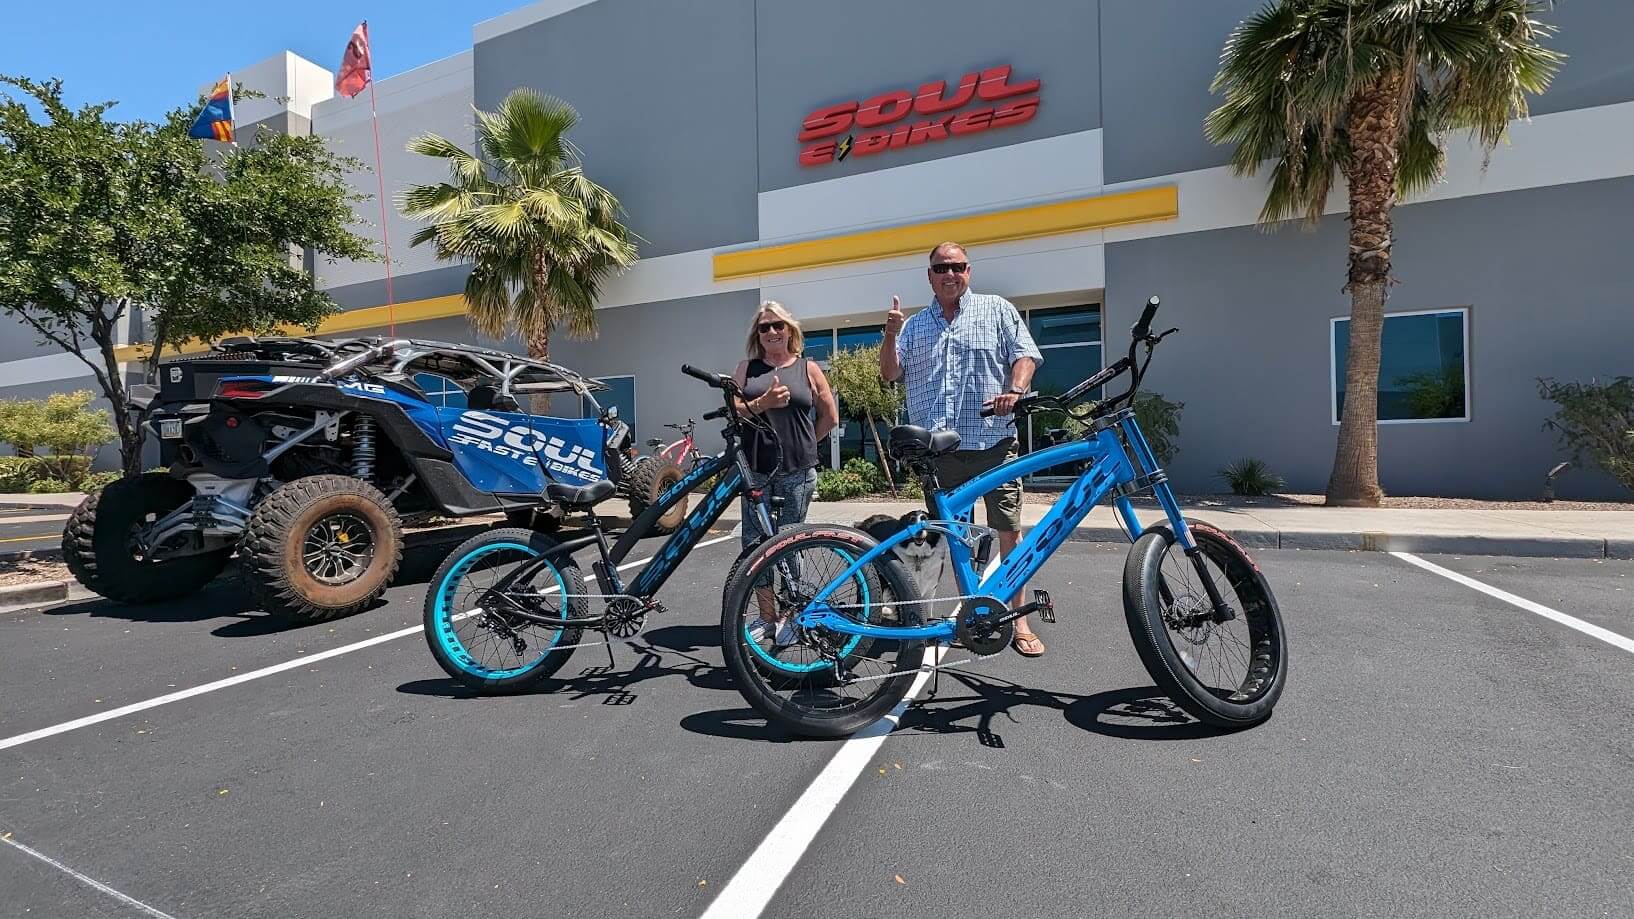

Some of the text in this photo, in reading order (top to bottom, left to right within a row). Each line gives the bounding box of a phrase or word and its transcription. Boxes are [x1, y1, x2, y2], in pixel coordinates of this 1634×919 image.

[798, 64, 1040, 143] SOUL
[447, 433, 525, 460] FAST
[452, 410, 603, 475] SOUL
[638, 473, 741, 592] SOUL
[1005, 456, 1121, 588] SOUL
